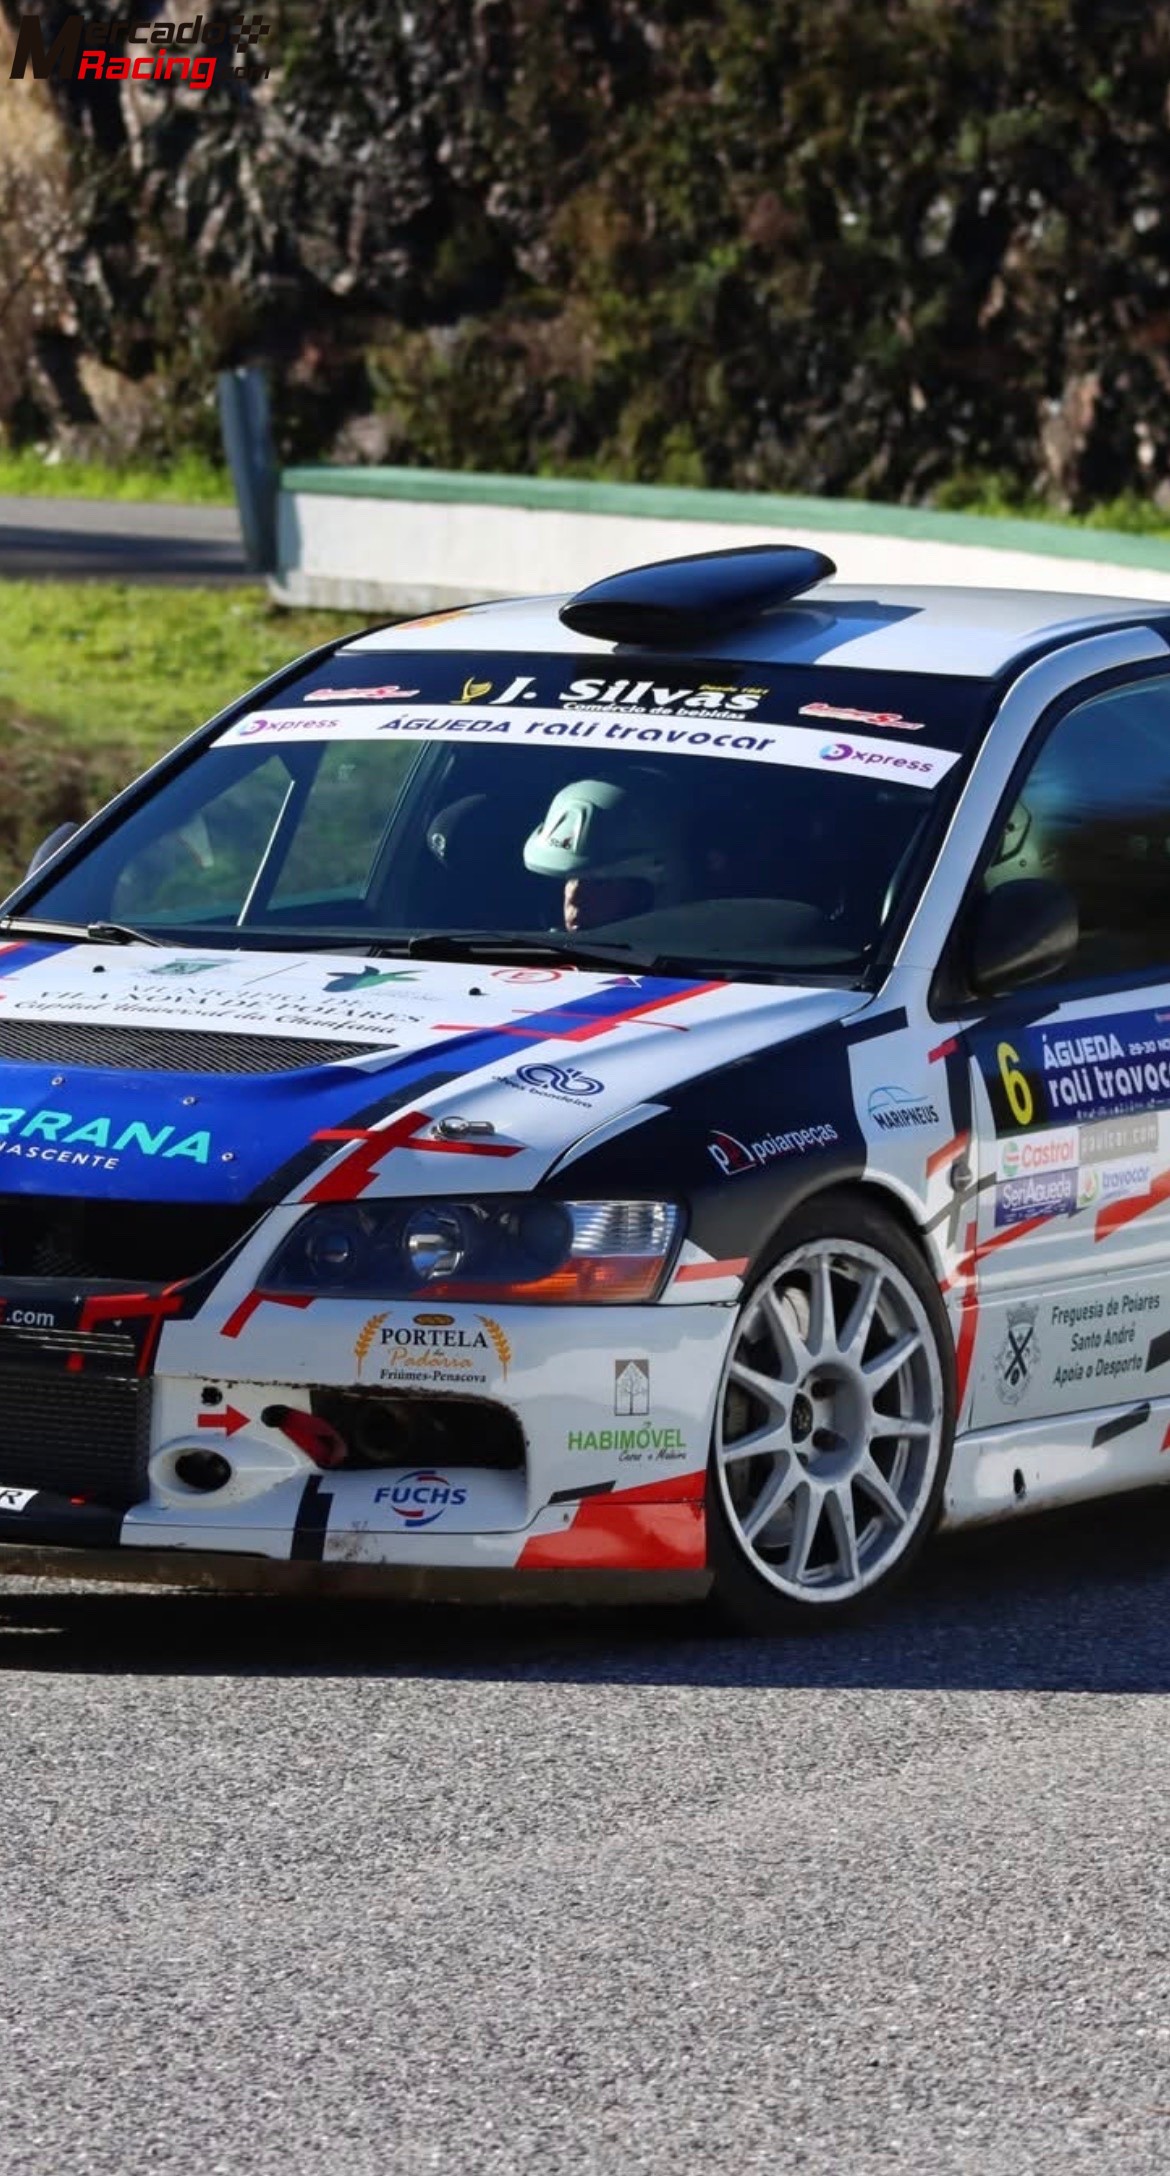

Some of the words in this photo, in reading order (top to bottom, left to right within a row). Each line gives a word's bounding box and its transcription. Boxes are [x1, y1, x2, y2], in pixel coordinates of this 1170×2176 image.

[488, 677, 537, 705] J.
[558, 679, 761, 711] Silvas
[563, 702, 646, 714] Comércio
[648, 706, 673, 717] de
[674, 707, 747, 720] bebidas
[376, 713, 511, 734] ÁGUEDA
[525, 721, 600, 737] rali
[605, 724, 777, 752] travocar
[273, 1003, 424, 1024] POIARES
[275, 1014, 397, 1035] Chanfana
[1042, 1034, 1125, 1070] ÁGUEDA
[997, 1042, 1034, 1126] 6
[1048, 1068, 1093, 1107] rali
[872, 1105, 941, 1132] MARIPNEUS
[751, 1121, 839, 1164] poiarpeças
[1021, 1140, 1074, 1168] Castrol
[1051, 1301, 1103, 1327] Freguesia
[1106, 1299, 1119, 1315] de
[1122, 1293, 1160, 1314] Poiares
[381, 1328, 489, 1348] PORTELA
[1071, 1333, 1101, 1352] Santo
[1104, 1321, 1136, 1348] André
[380, 1369, 487, 1383] Friúmes-Penacova
[1053, 1363, 1085, 1388] Apoia
[1095, 1354, 1143, 1380] Desporto
[567, 1421, 687, 1451] HABIMÓVEL
[374, 1487, 468, 1505] FUCHS
